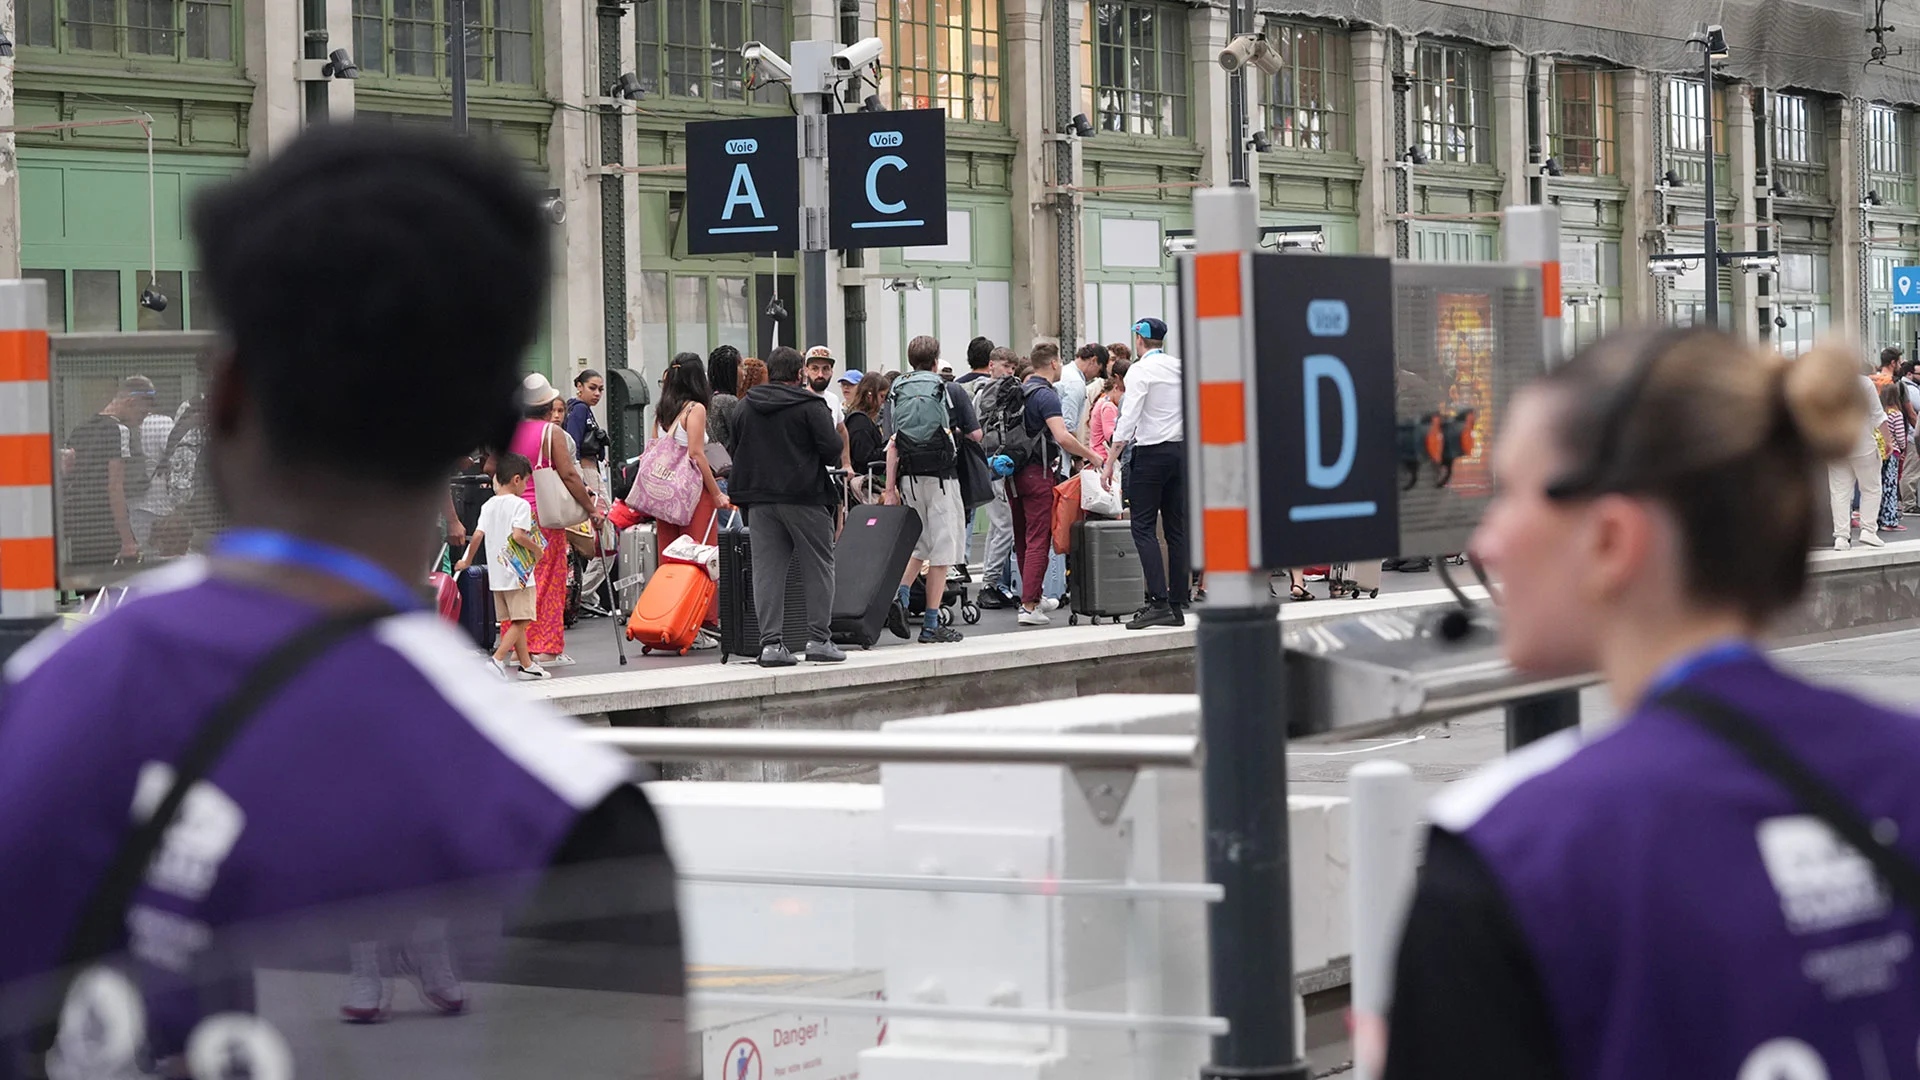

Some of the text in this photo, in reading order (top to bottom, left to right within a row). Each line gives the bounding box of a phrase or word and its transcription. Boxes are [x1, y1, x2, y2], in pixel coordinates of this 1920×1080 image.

[729, 141, 753, 153] Voie
[874, 134, 898, 145] Voie
[721, 163, 765, 220] A
[865, 154, 909, 214] C
[1302, 354, 1358, 490] D
[773, 1023, 819, 1048] Danger
